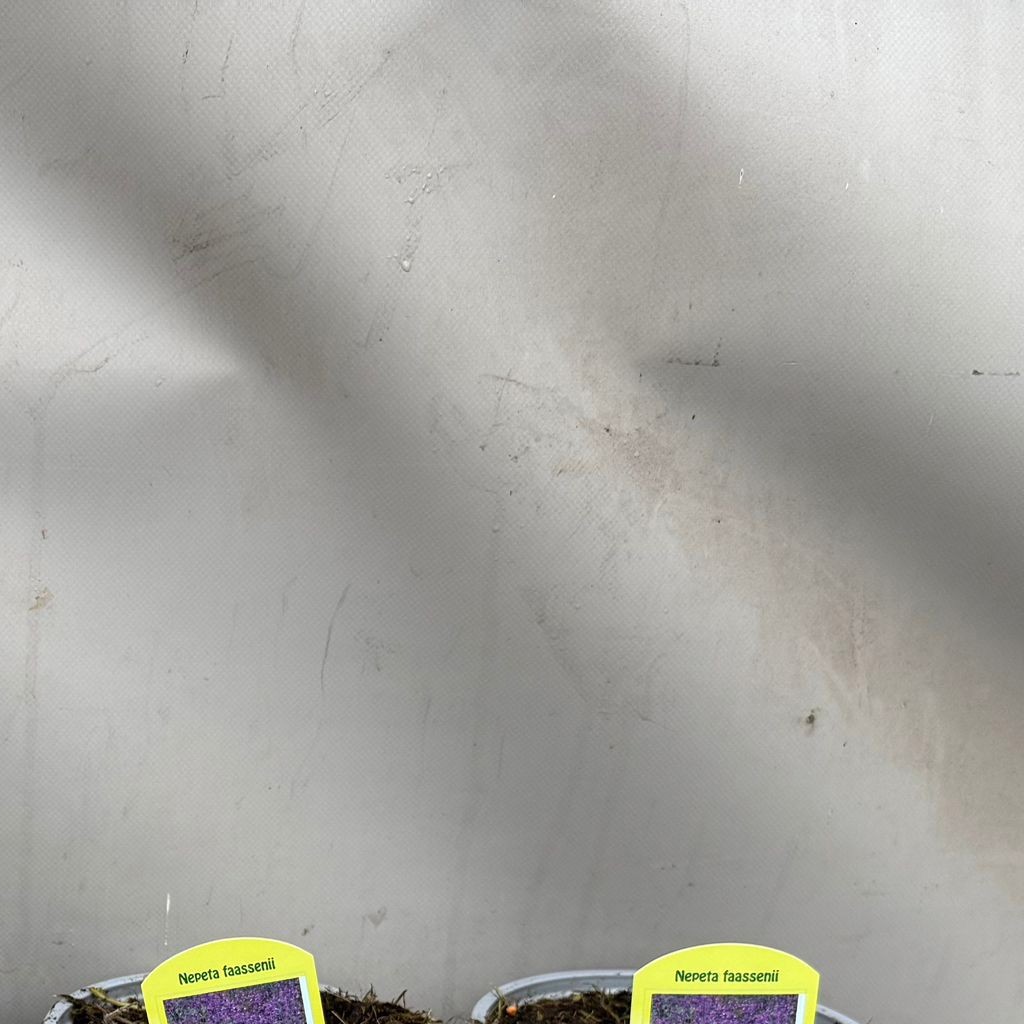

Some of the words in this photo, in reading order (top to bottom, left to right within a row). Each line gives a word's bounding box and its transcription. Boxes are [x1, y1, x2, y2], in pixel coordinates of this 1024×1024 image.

[178, 968, 220, 985] Nepeta
[222, 957, 276, 978] faassenii
[675, 969, 719, 983] Nepeta
[723, 969, 780, 983] faassenii
